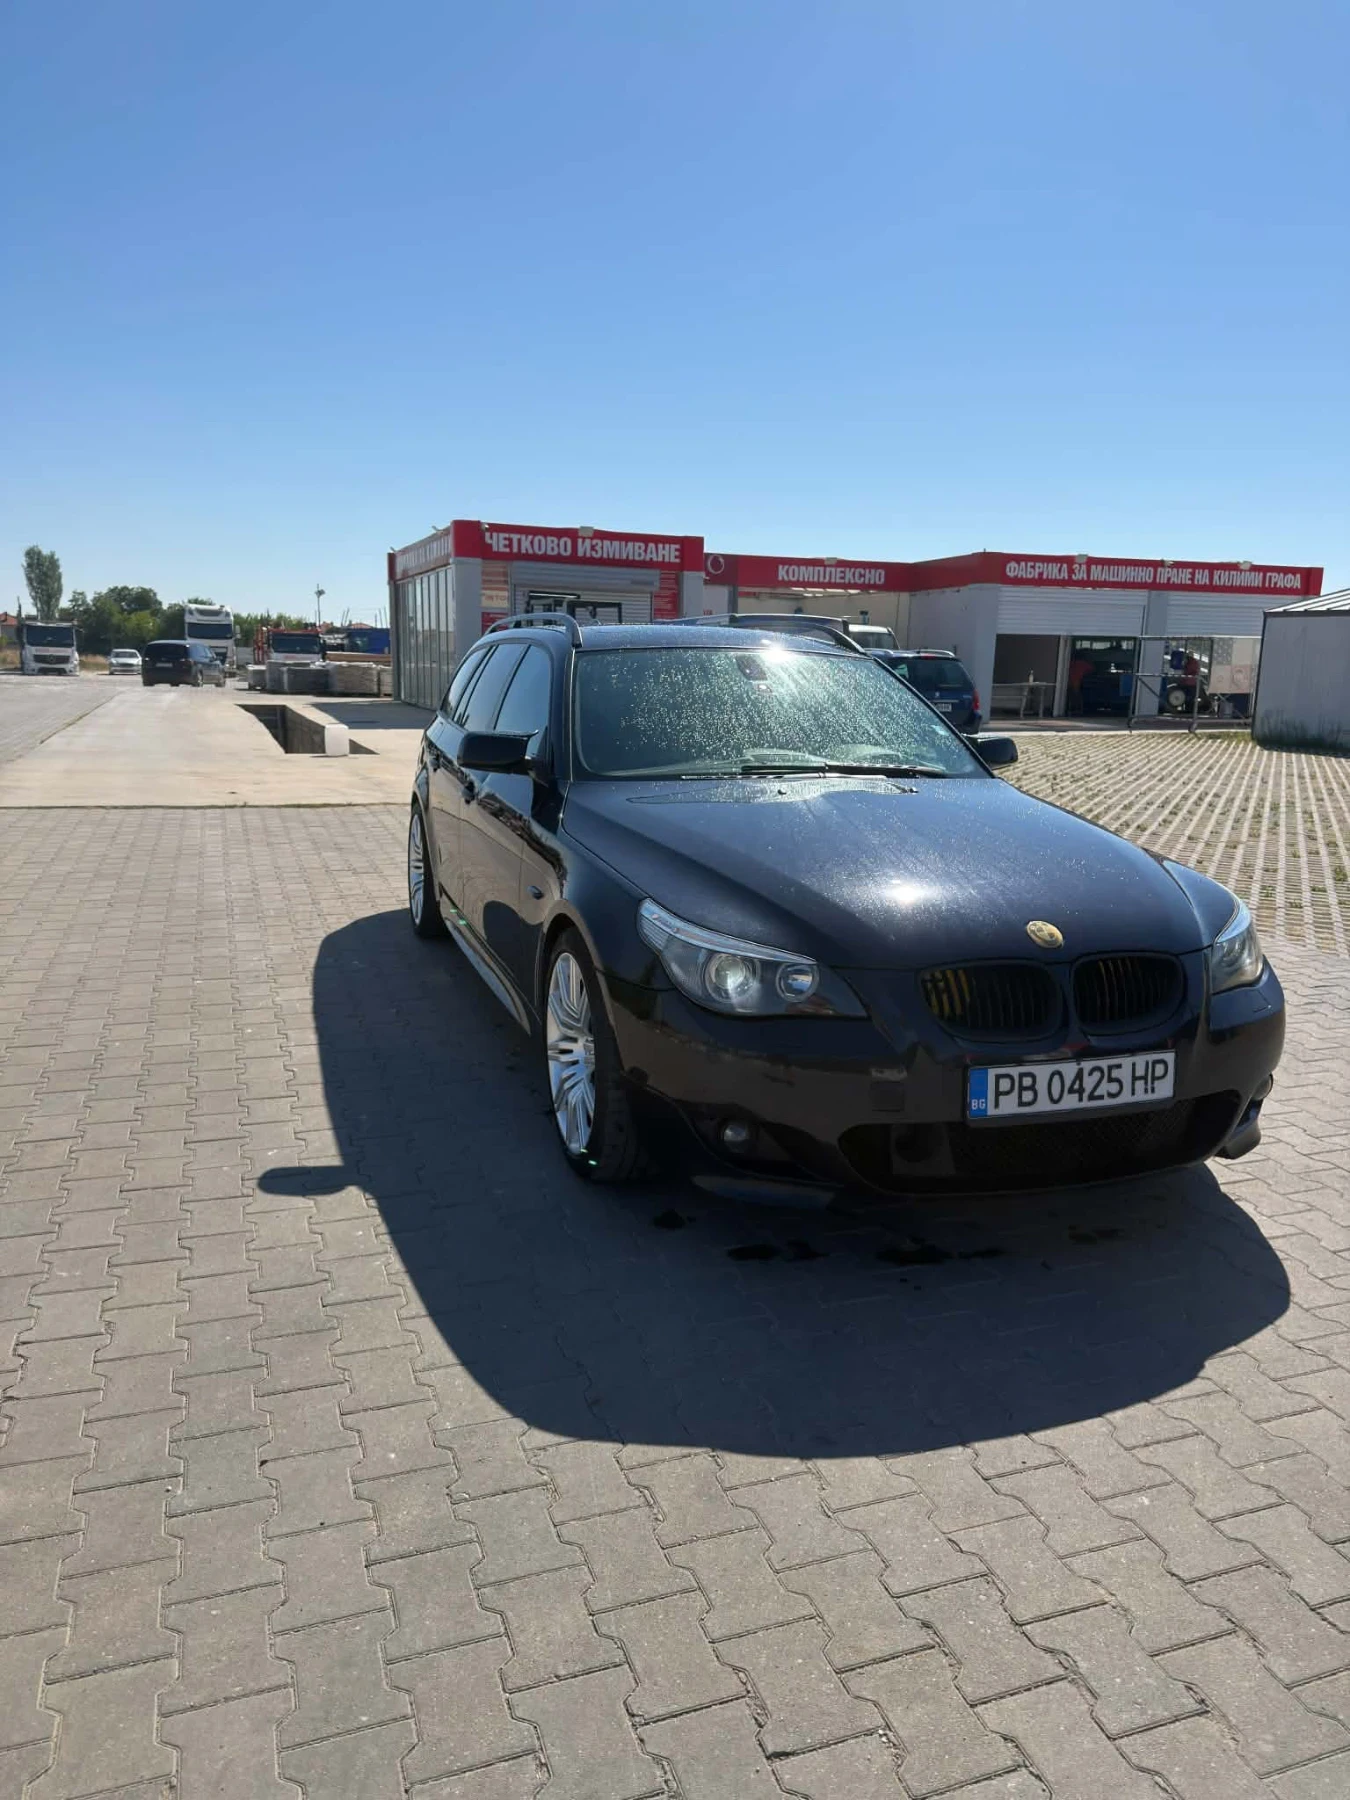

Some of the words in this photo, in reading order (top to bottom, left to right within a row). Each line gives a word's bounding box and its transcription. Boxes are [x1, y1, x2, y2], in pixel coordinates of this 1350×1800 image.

[485, 532, 572, 556] ЧЕТКОВО
[577, 538, 681, 562] ИЗМИВАНЕ
[777, 564, 886, 585] КОМПЛЕКСНО
[1005, 561, 1068, 580] ФАБРИКА
[1072, 564, 1088, 580] ЗА
[1090, 565, 1154, 583] МАШИННО
[1156, 567, 1192, 584] ПРАНЕ
[1194, 568, 1210, 585] НА
[1212, 570, 1263, 588] КИЛИМИ
[1265, 572, 1301, 589] ГРАФА
[993, 1071, 1038, 1110] PB
[1047, 1063, 1124, 1105] 0425
[1131, 1058, 1169, 1097] HP
[971, 1098, 986, 1110] BG
